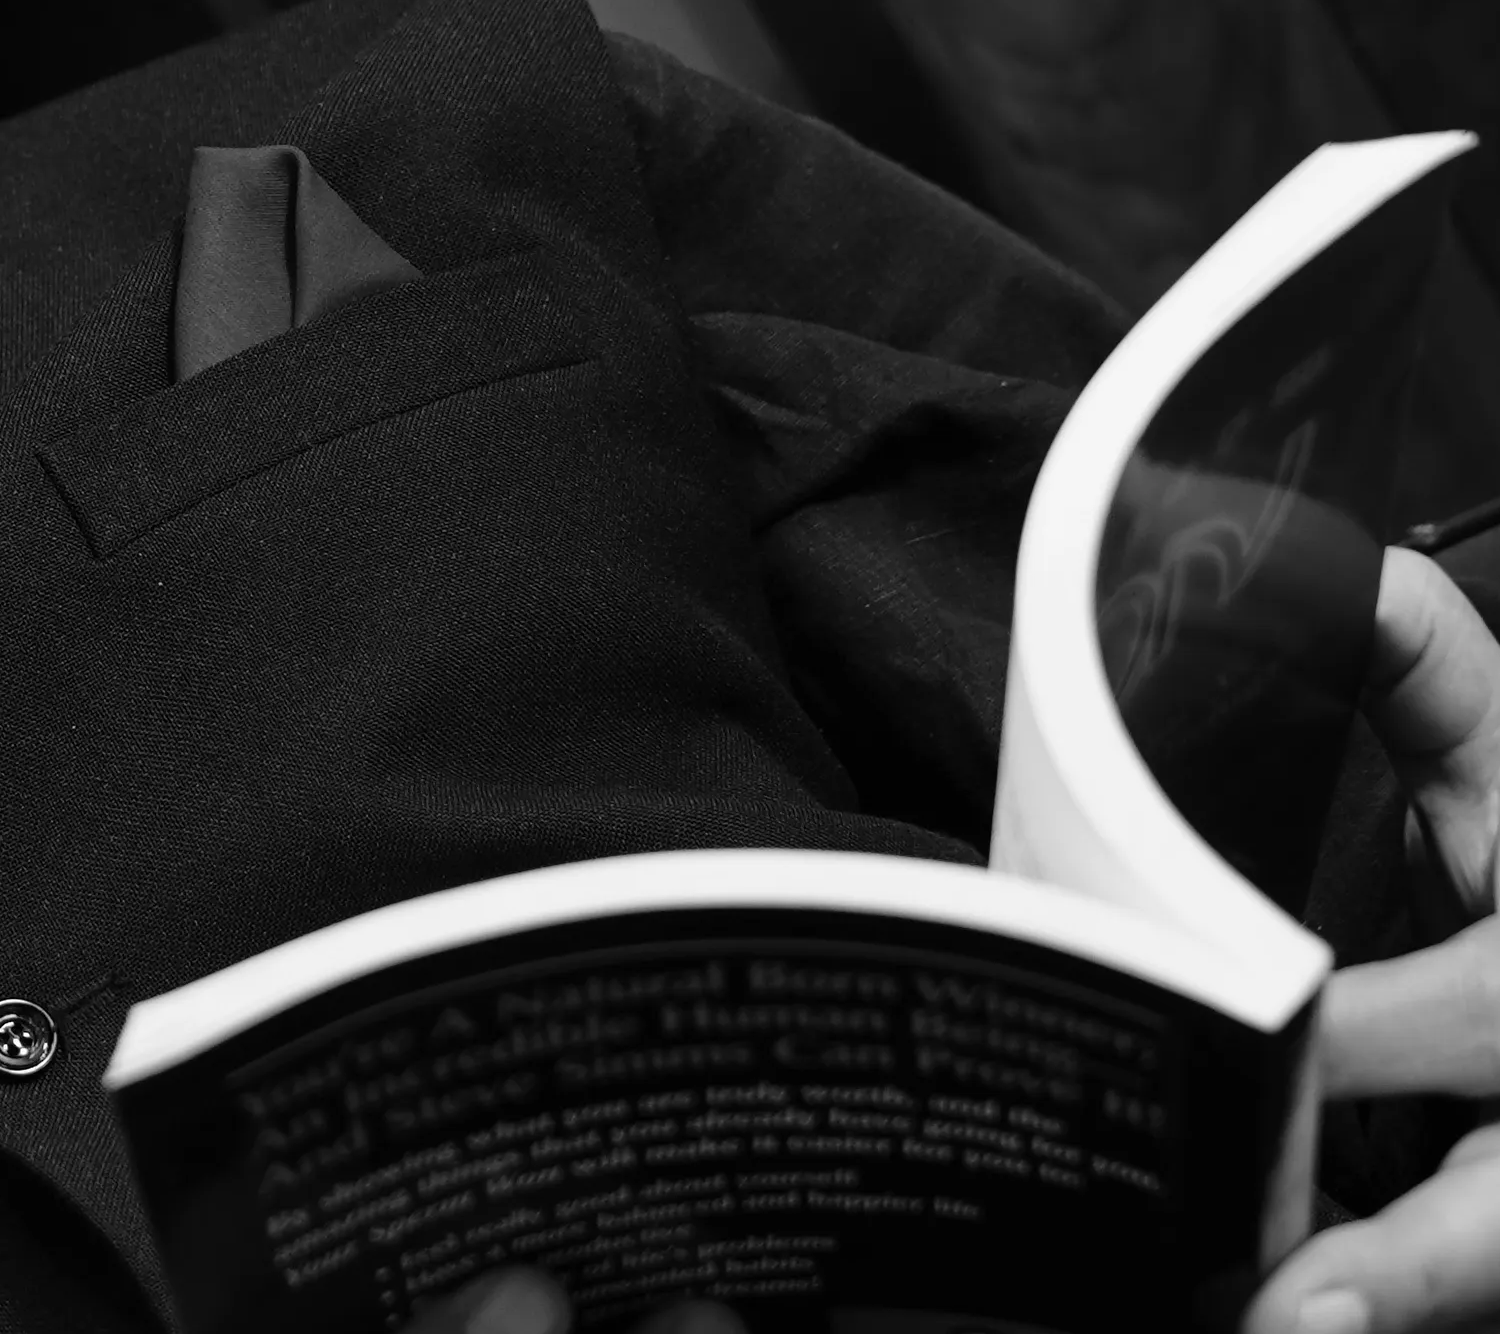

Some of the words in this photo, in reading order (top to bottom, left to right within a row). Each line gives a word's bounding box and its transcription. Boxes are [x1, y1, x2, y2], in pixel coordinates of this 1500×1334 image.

[498, 962, 725, 1019] Natural
[747, 961, 899, 1001] Born
[345, 1014, 641, 1112] Incredible
[662, 1003, 891, 1037] Human
[259, 1118, 369, 1197] And
[384, 1071, 537, 1132] Steve
[773, 1034, 895, 1073] Can
[915, 1045, 1080, 1102] Prove
[466, 1113, 555, 1150] what
[562, 1099, 632, 1129] you
[637, 1090, 697, 1115] are
[928, 1094, 1001, 1120] and
[1008, 1105, 1067, 1137] the
[417, 1150, 523, 1195] things
[530, 1130, 602, 1160] that
[609, 1118, 680, 1145] you
[687, 1106, 816, 1134] already
[828, 1108, 912, 1133] have
[923, 1118, 1023, 1153] going
[1031, 1137, 1082, 1164] for
[645, 1137, 740, 1165] make
[902, 1138, 954, 1162] for
[963, 1150, 1031, 1178] you
[554, 1185, 633, 1218] good
[637, 1172, 726, 1199] about
[741, 1191, 801, 1211] and
[807, 1191, 923, 1214] happier
